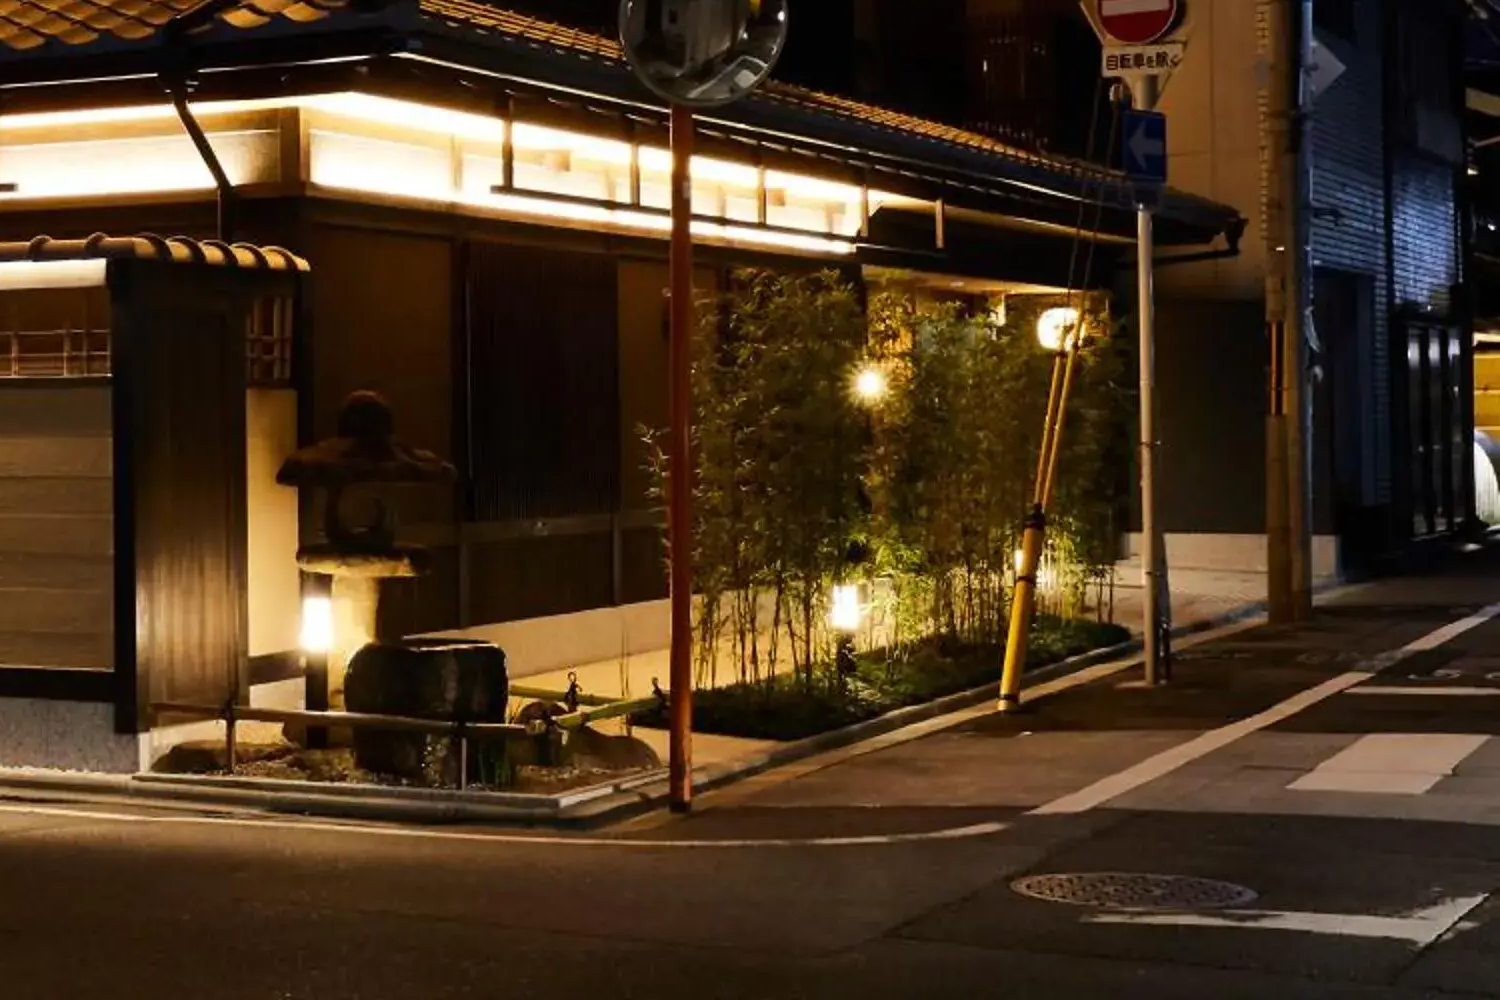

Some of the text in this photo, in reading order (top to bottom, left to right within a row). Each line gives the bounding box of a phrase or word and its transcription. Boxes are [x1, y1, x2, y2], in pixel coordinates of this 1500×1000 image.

[1106, 51, 1182, 71] 自転車を除く
